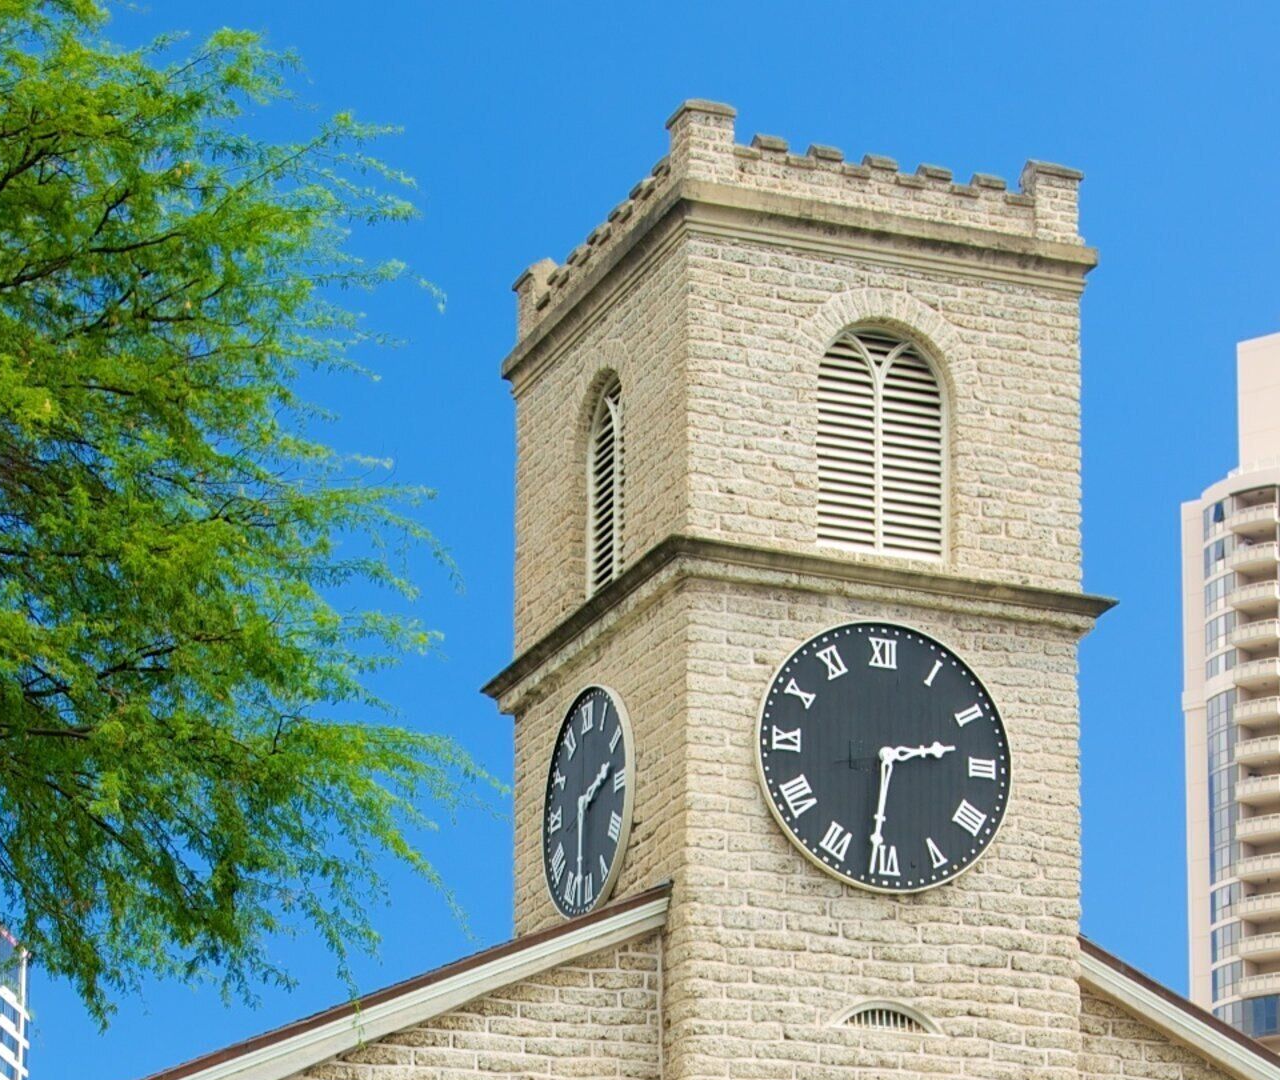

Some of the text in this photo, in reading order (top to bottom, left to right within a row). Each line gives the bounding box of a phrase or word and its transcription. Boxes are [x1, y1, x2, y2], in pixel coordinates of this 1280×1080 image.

[816, 645, 848, 680] XI
[869, 636, 897, 669] XII
[924, 660, 943, 687] I
[784, 678, 816, 709] X
[954, 703, 983, 727] II
[772, 725, 801, 752] IX
[968, 757, 996, 780] III
[779, 774, 817, 818] VIII
[819, 821, 852, 861] VII
[926, 838, 948, 869] V
